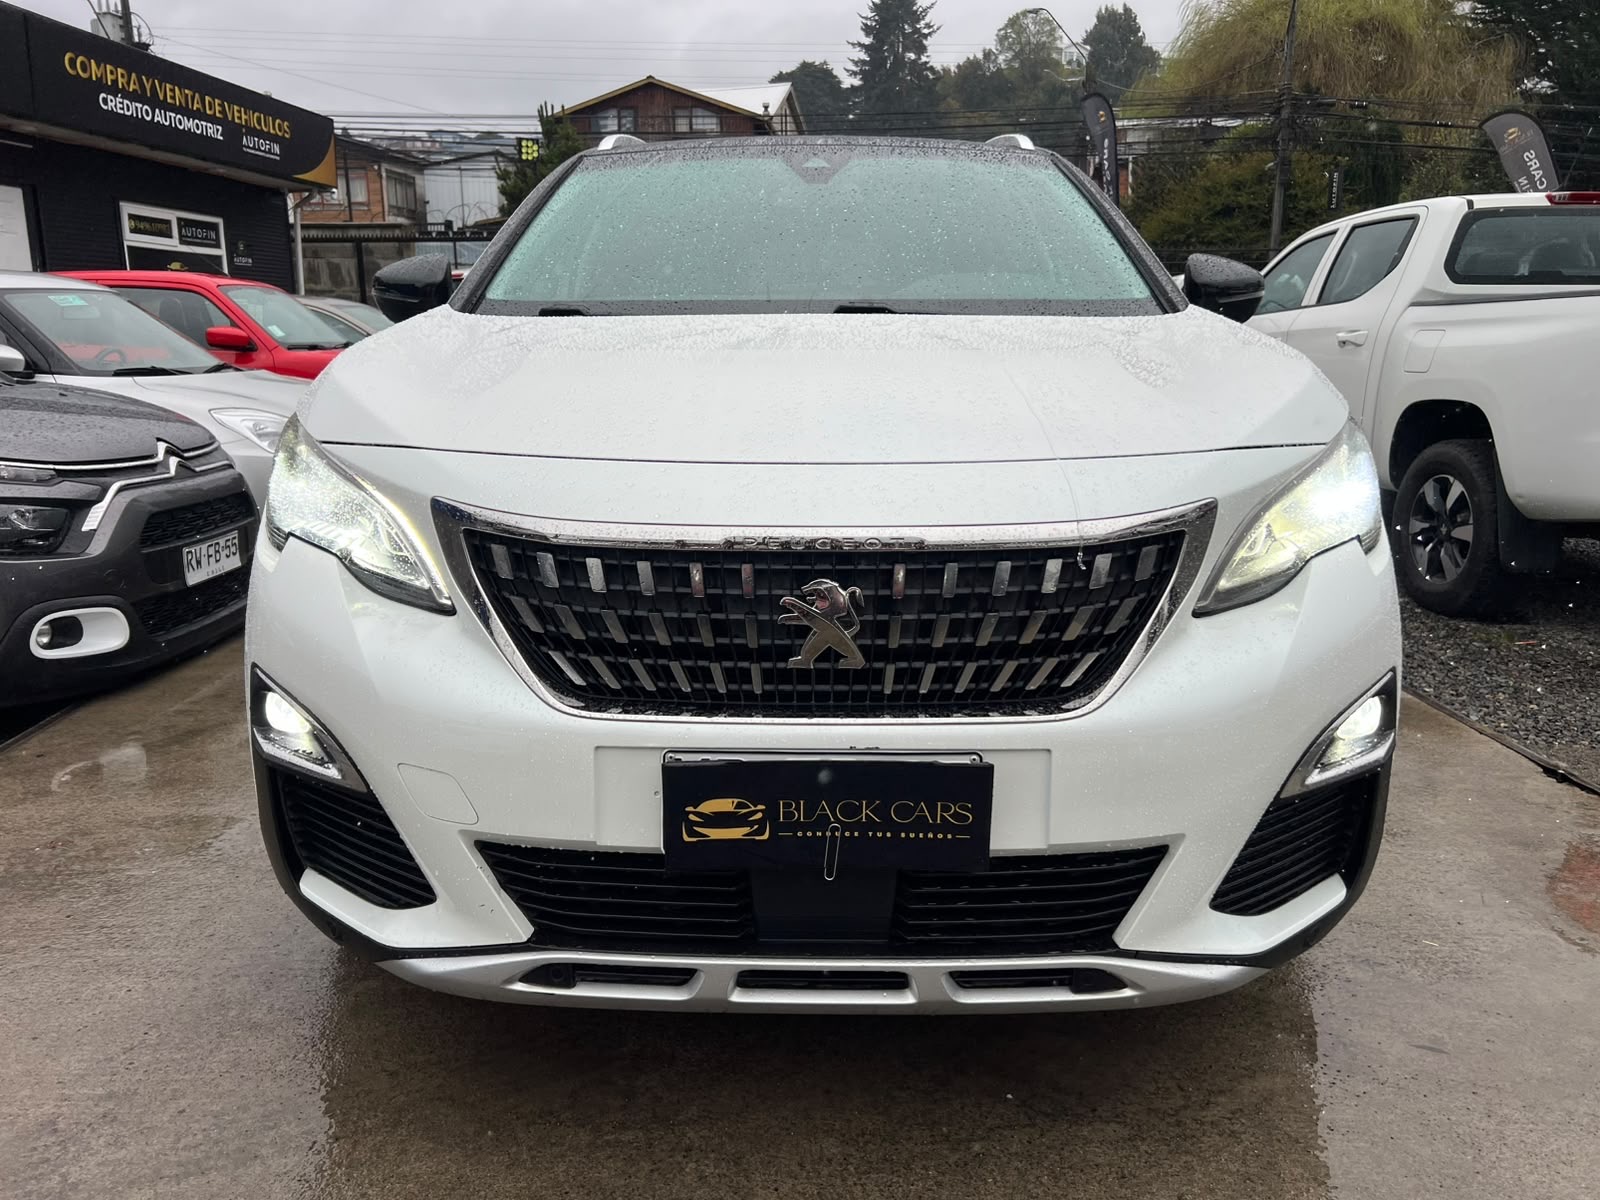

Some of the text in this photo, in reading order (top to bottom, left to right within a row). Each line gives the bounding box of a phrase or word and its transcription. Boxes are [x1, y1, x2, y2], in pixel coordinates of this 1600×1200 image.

[64, 52, 291, 139] COMPRA Y VENTA DE VEHICULOS
[99, 93, 224, 140] CRÉDITO AUTOMOTRIZ
[242, 135, 280, 155] AUTOFIN
[181, 227, 216, 240] AUTOFIN
[778, 799, 973, 825] BLACK CARS
[901, 831, 953, 839] SUEÑOS
